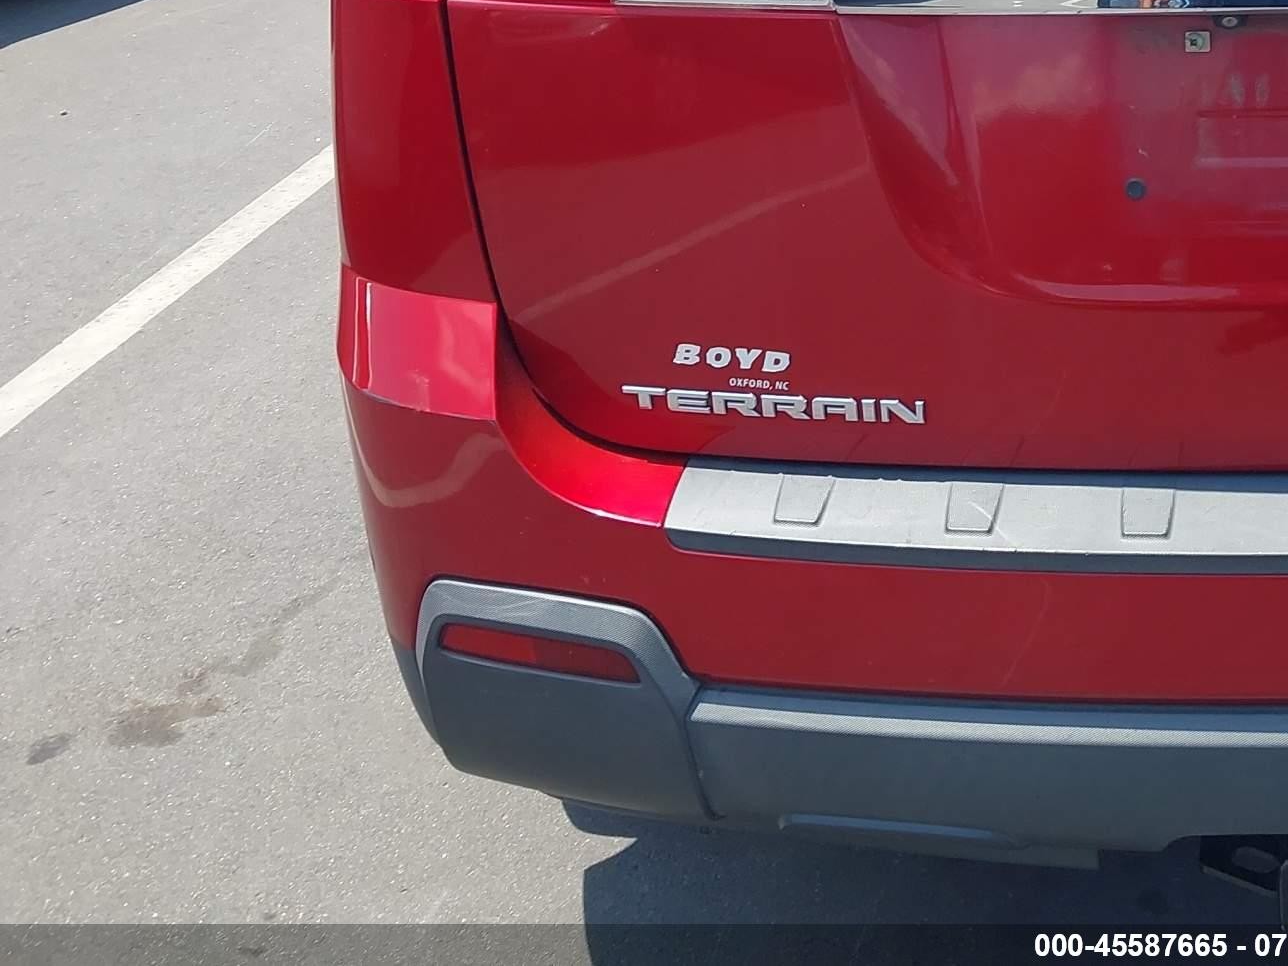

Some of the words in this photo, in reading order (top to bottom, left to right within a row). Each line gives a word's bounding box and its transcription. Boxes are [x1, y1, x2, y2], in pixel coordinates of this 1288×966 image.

[673, 343, 790, 373] BOYD
[729, 377, 773, 390] OXFORD,
[775, 381, 789, 391] NC
[621, 385, 925, 424] TERRAIN
